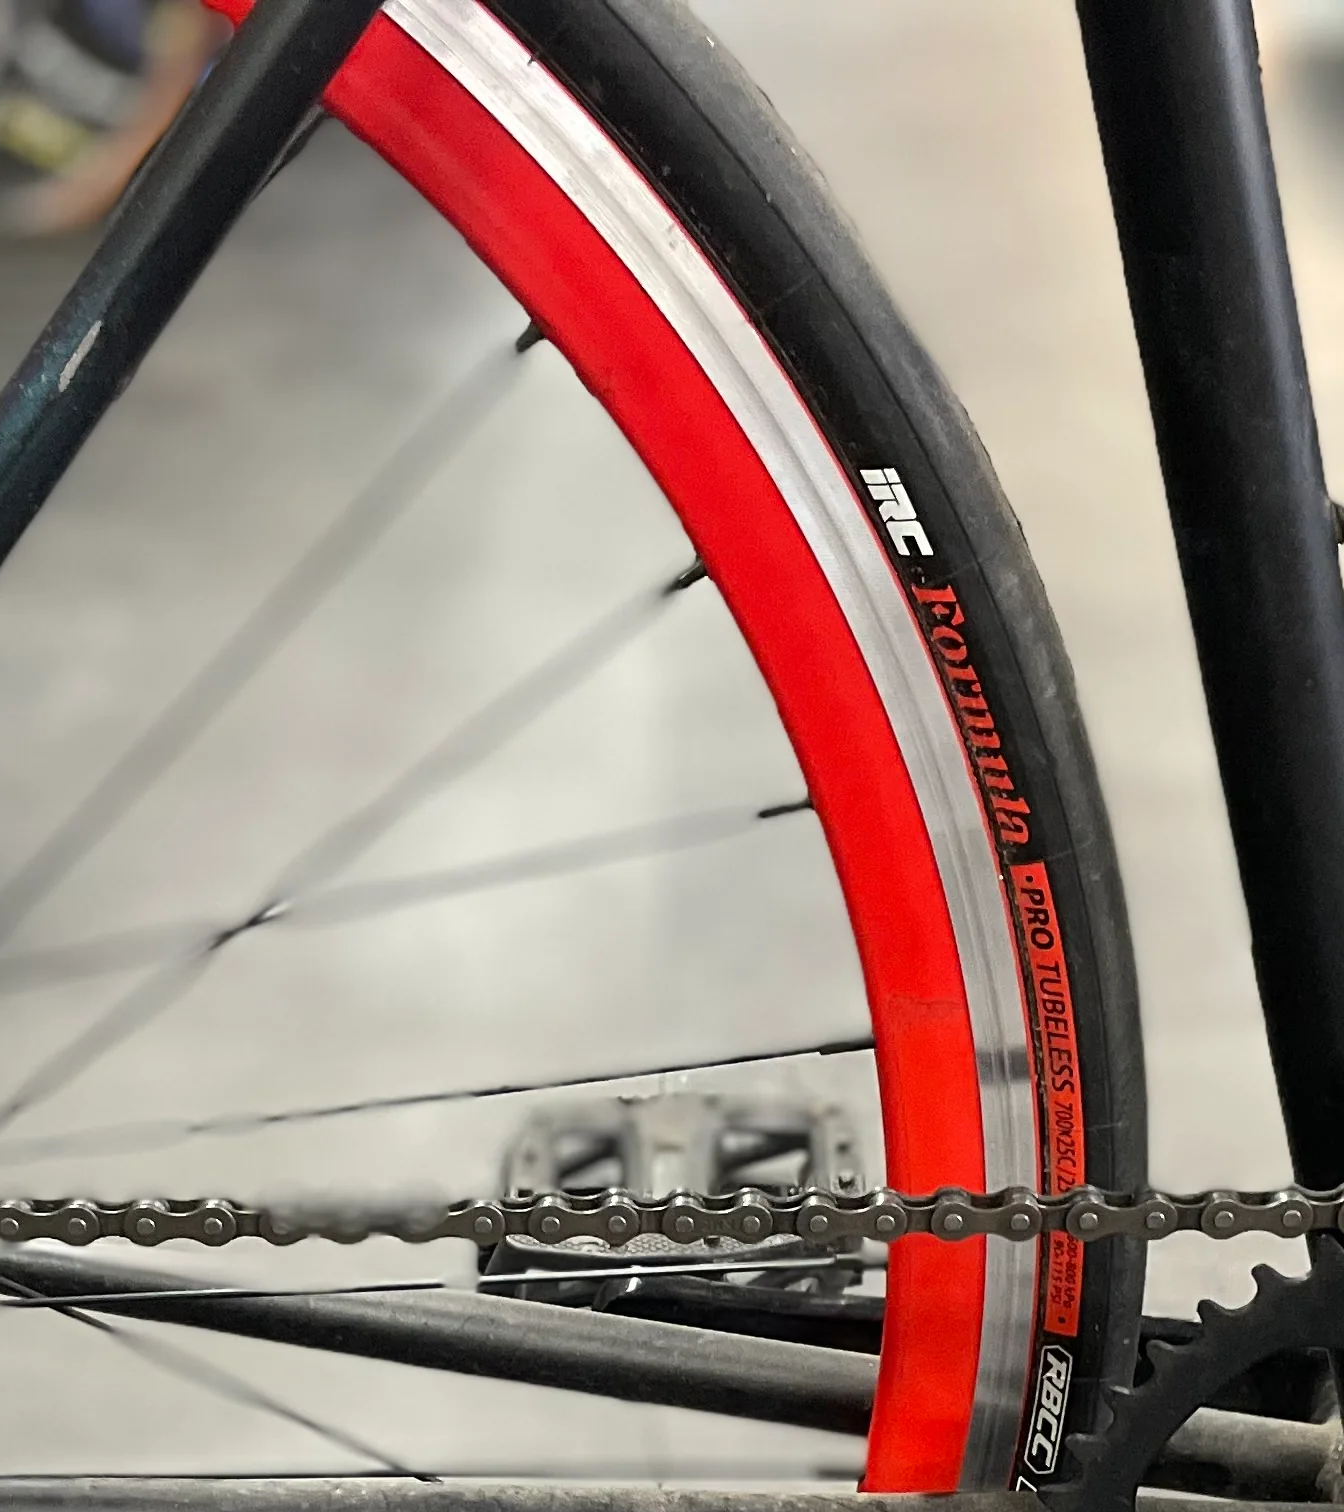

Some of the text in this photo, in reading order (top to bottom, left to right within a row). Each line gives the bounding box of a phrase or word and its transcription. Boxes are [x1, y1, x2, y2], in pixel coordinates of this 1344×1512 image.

[912, 584, 1031, 845] Formula
[1020, 885, 1054, 950] PRO
[1036, 960, 1073, 1093] TUBELESS
[1032, 1352, 1068, 1469] RBCC
